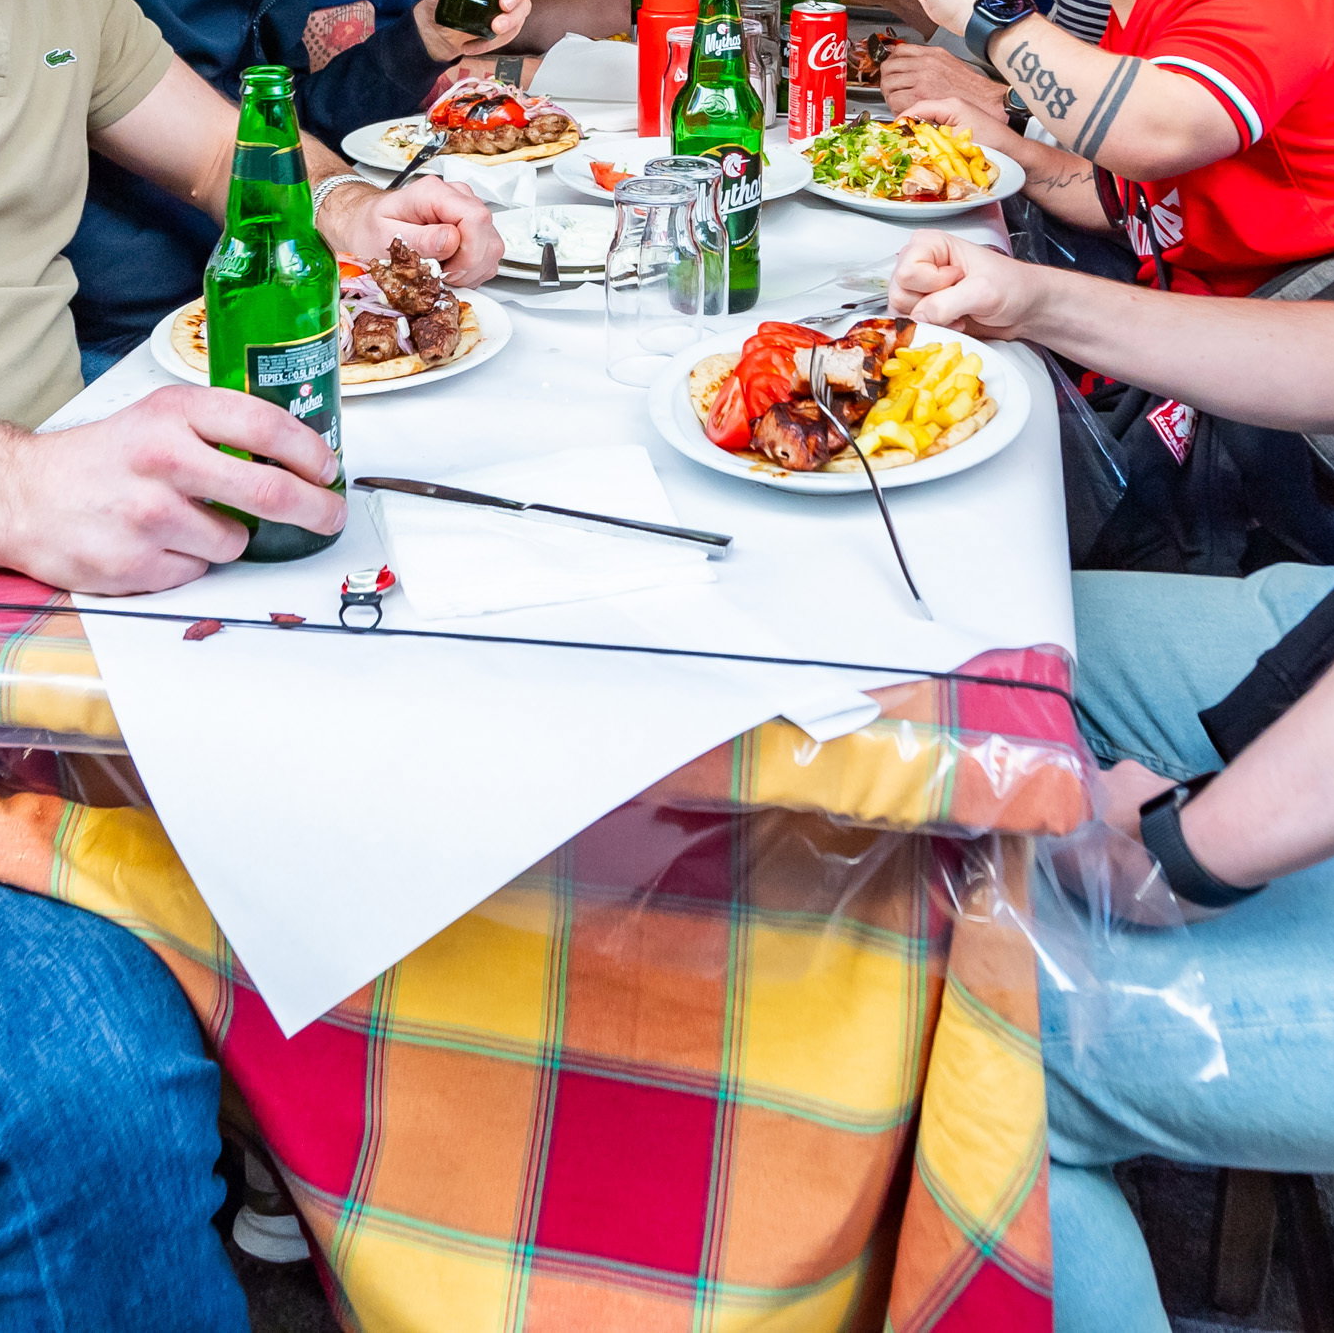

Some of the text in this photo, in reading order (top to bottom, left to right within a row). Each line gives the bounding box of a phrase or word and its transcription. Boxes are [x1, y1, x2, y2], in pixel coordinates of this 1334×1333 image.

[704, 33, 742, 57] Mythos
[1006, 41, 1078, 120] 1998
[289, 393, 324, 419] Mythos
